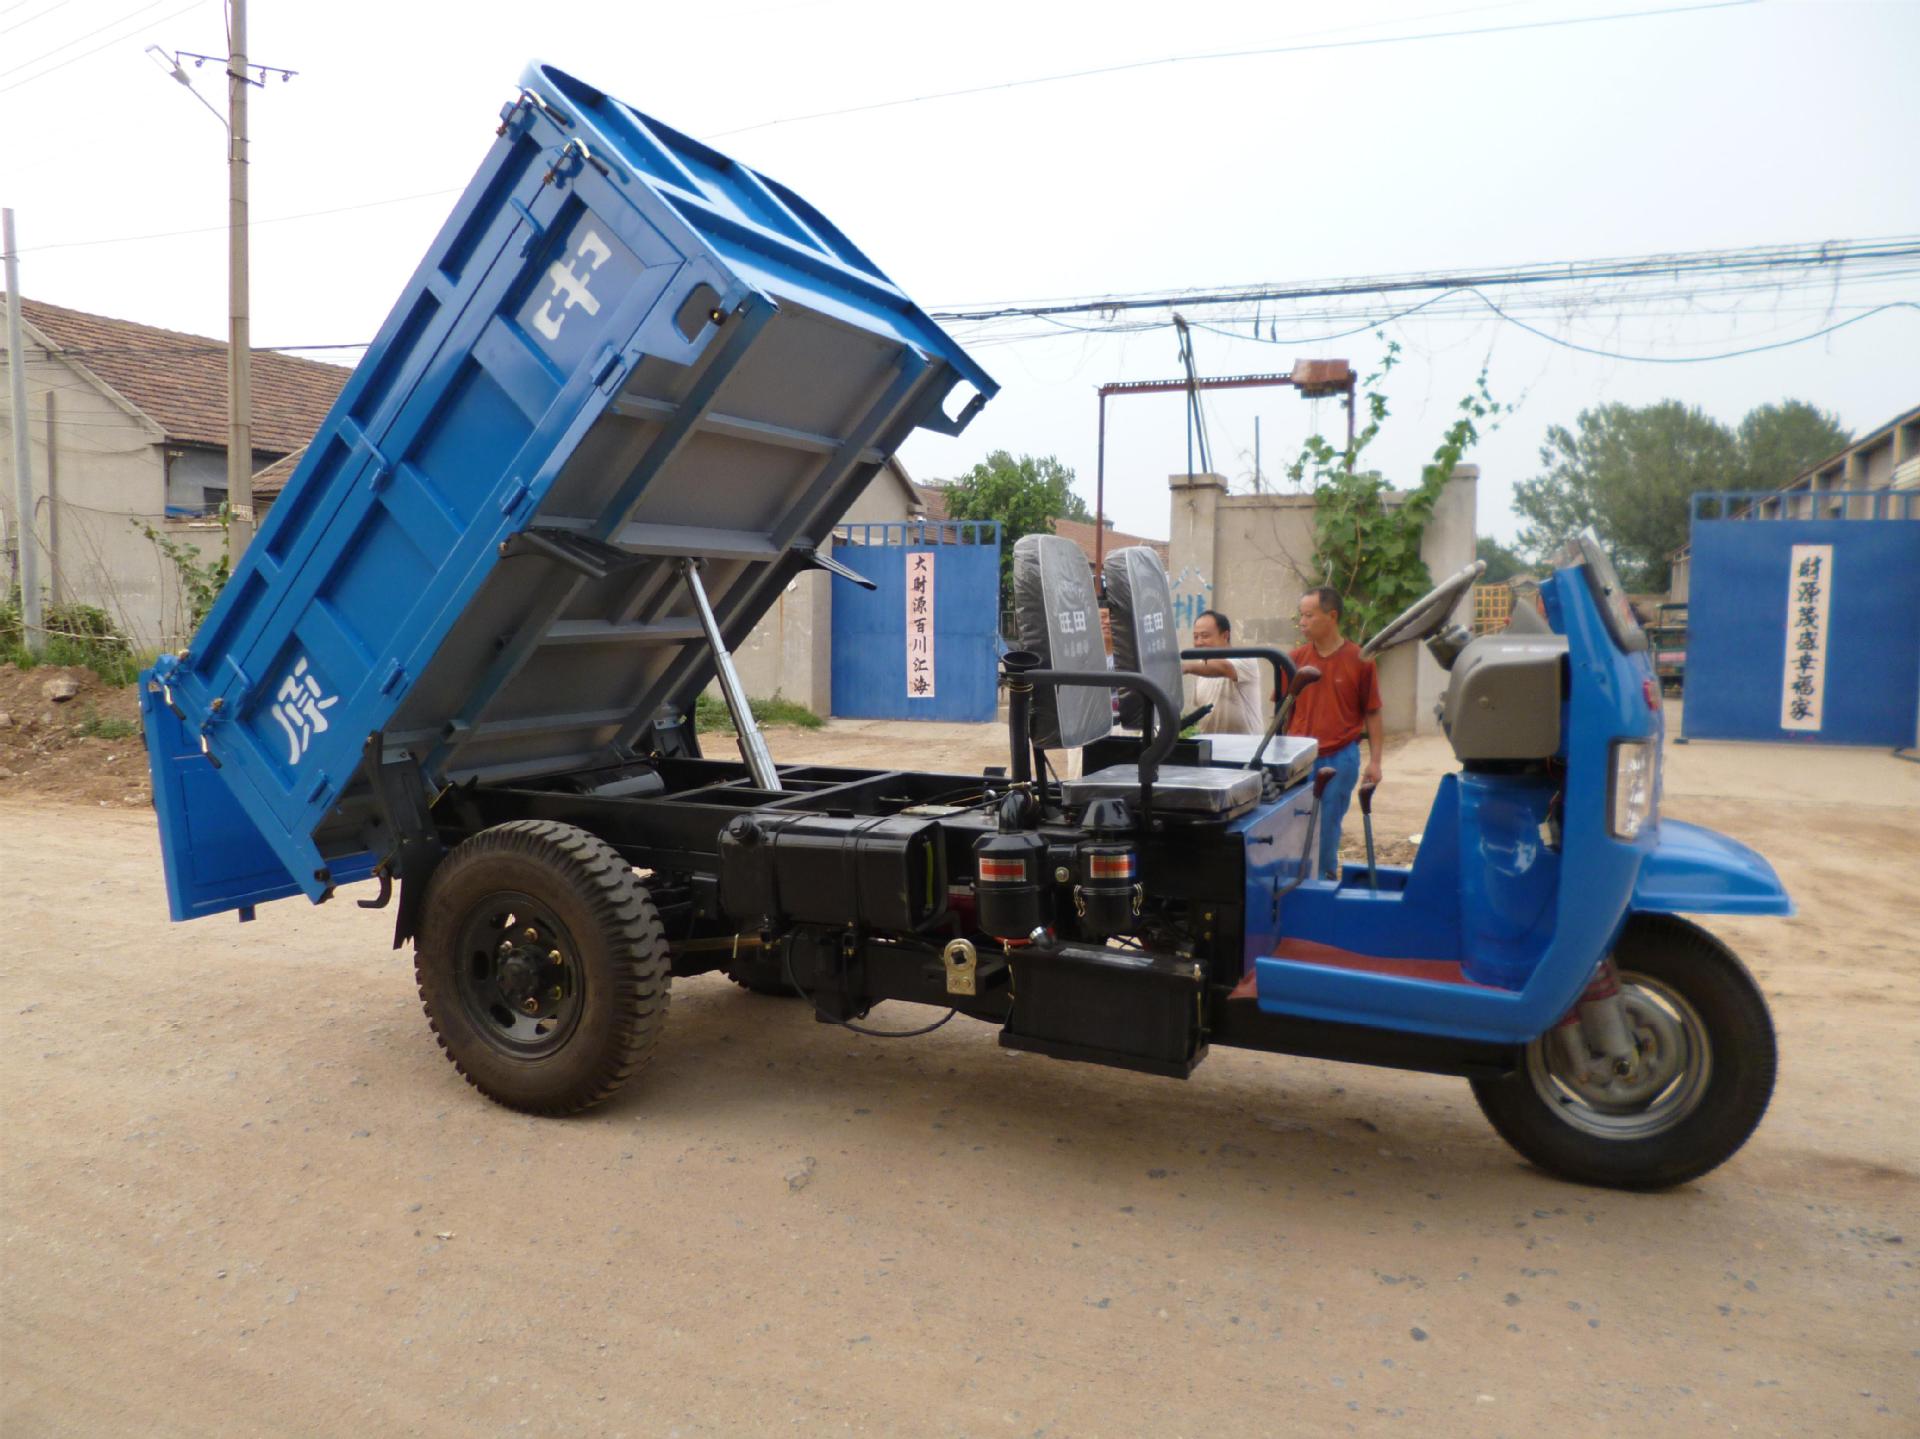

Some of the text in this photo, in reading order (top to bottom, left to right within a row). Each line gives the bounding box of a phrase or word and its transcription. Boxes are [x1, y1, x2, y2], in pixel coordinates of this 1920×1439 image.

[533, 230, 612, 340] 中
[1059, 610, 1087, 634] 旺田
[271, 656, 338, 765] 原
